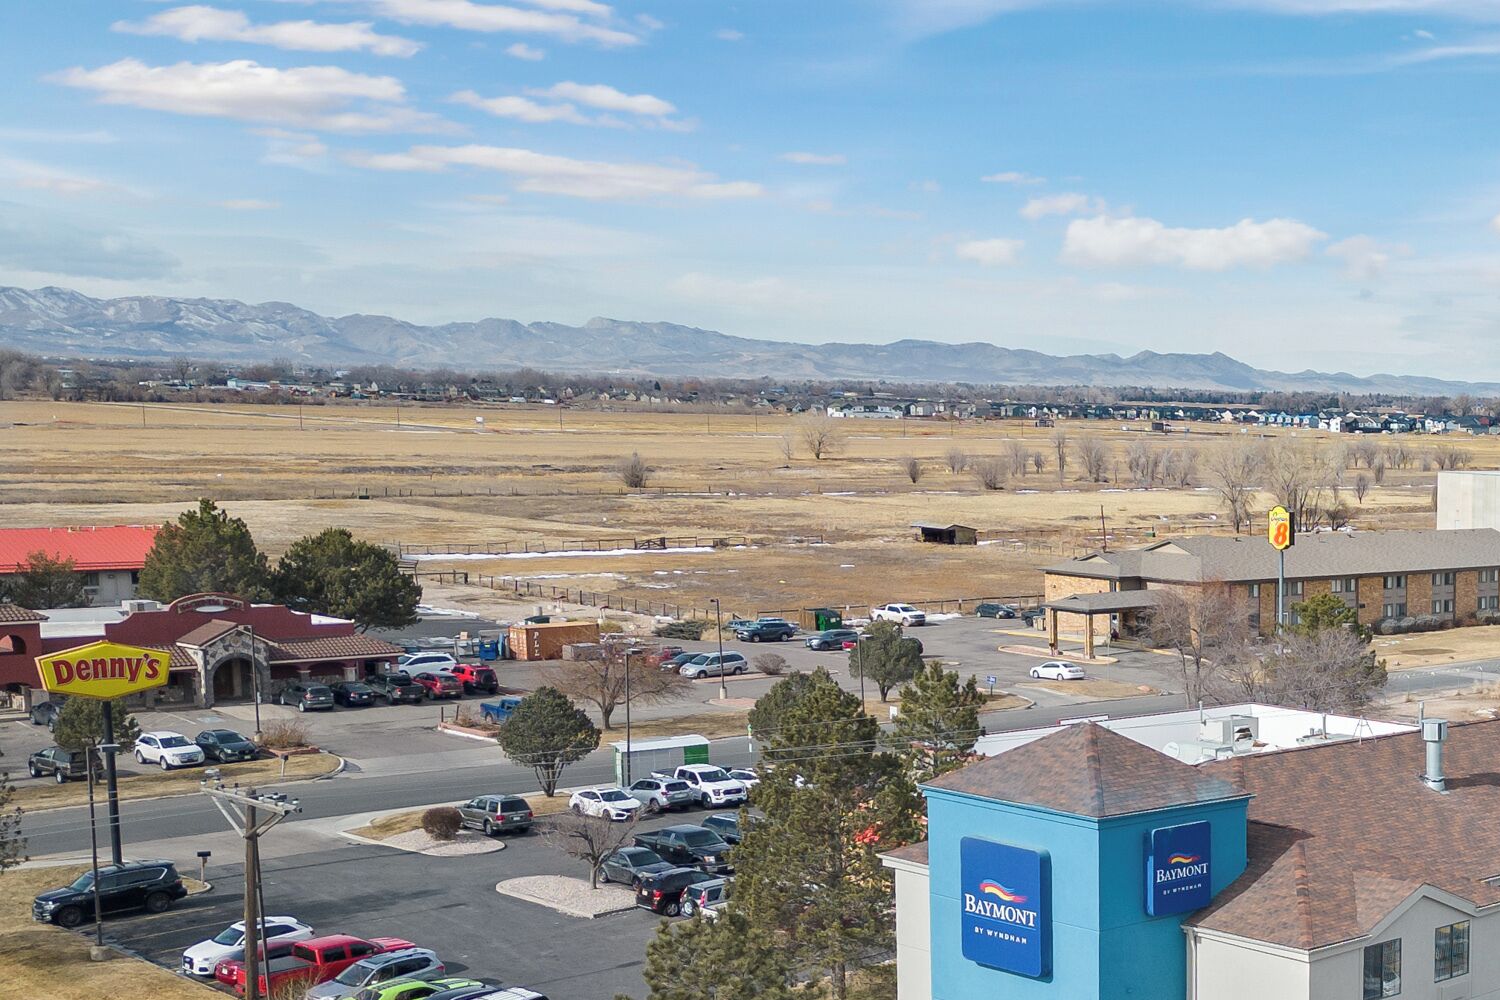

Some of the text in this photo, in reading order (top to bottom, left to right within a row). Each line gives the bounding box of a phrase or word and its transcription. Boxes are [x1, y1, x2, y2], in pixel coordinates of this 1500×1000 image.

[1273, 522, 1289, 546] 8
[51, 653, 161, 686] Denny's
[974, 926, 1028, 946] BY WYNDHAM
